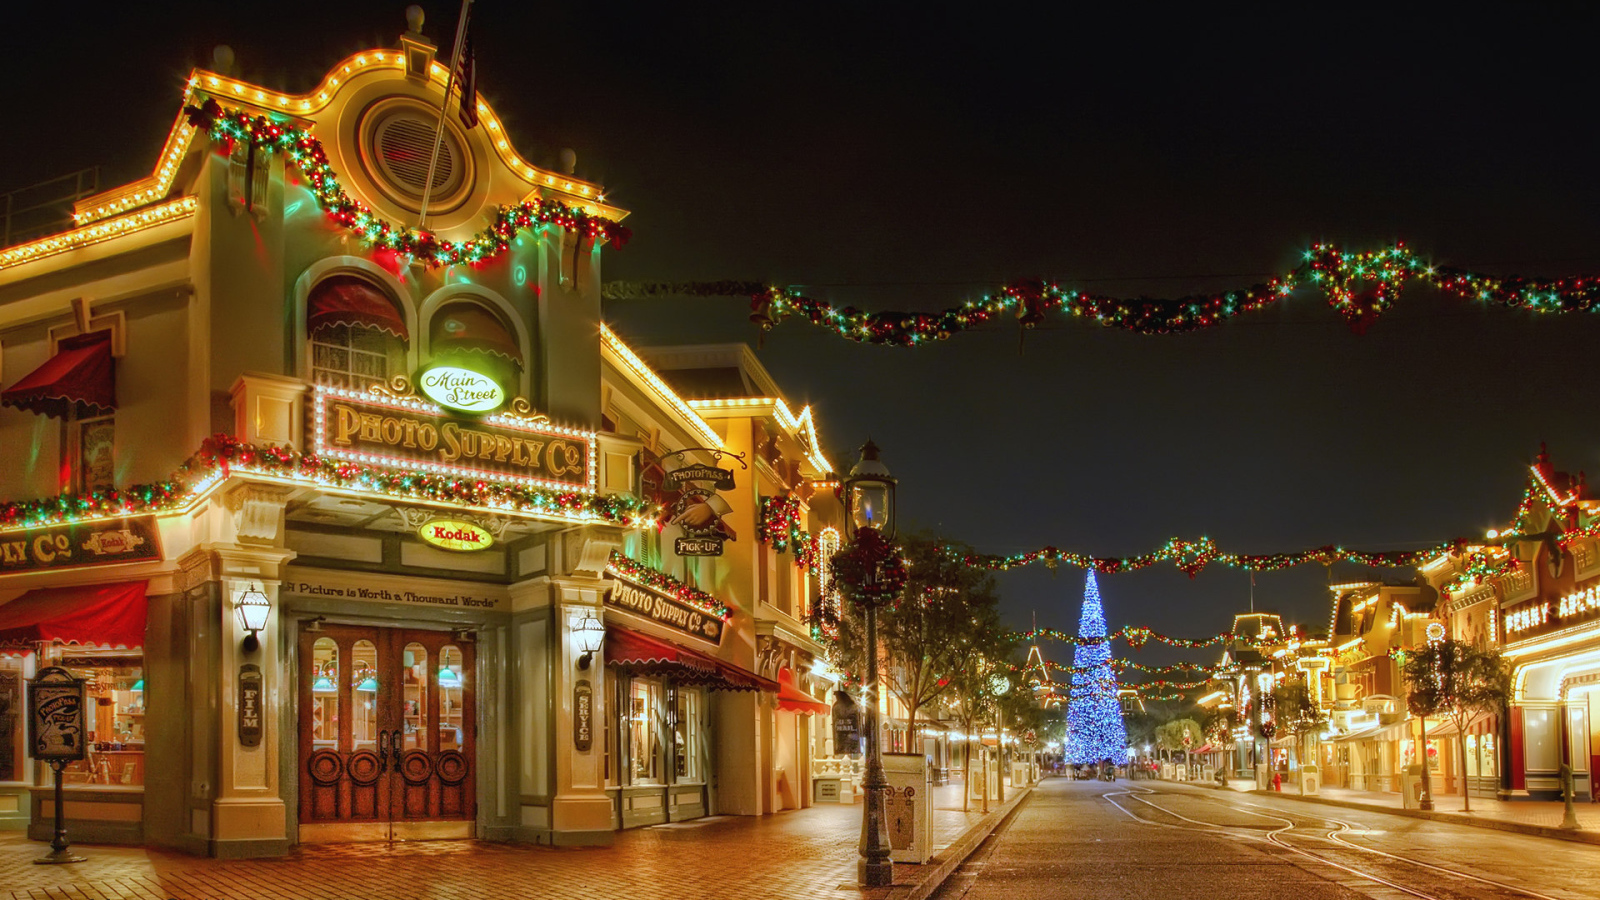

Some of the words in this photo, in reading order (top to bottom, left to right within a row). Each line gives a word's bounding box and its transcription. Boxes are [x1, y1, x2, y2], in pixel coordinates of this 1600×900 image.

[426, 371, 487, 390] Main
[446, 387, 497, 406] Street
[335, 404, 438, 451] PHOTO
[439, 422, 544, 467] SUPPLY
[100, 536, 124, 548] Kodak
[434, 526, 480, 542] Kodak
[0, 541, 27, 563] LY
[680, 542, 717, 551] PICK-UP
[299, 583, 343, 596] Picture
[347, 588, 356, 598] is
[359, 588, 392, 600] Worth
[394, 593, 401, 601] a
[404, 592, 458, 605] Thousand
[610, 578, 653, 612] PHOTO
[652, 597, 689, 627] SUPPLY
[1506, 602, 1549, 634] PENNY
[1559, 585, 1600, 618] ARCA
[243, 689, 258, 727] FILM
[579, 695, 589, 740] SERVICE
